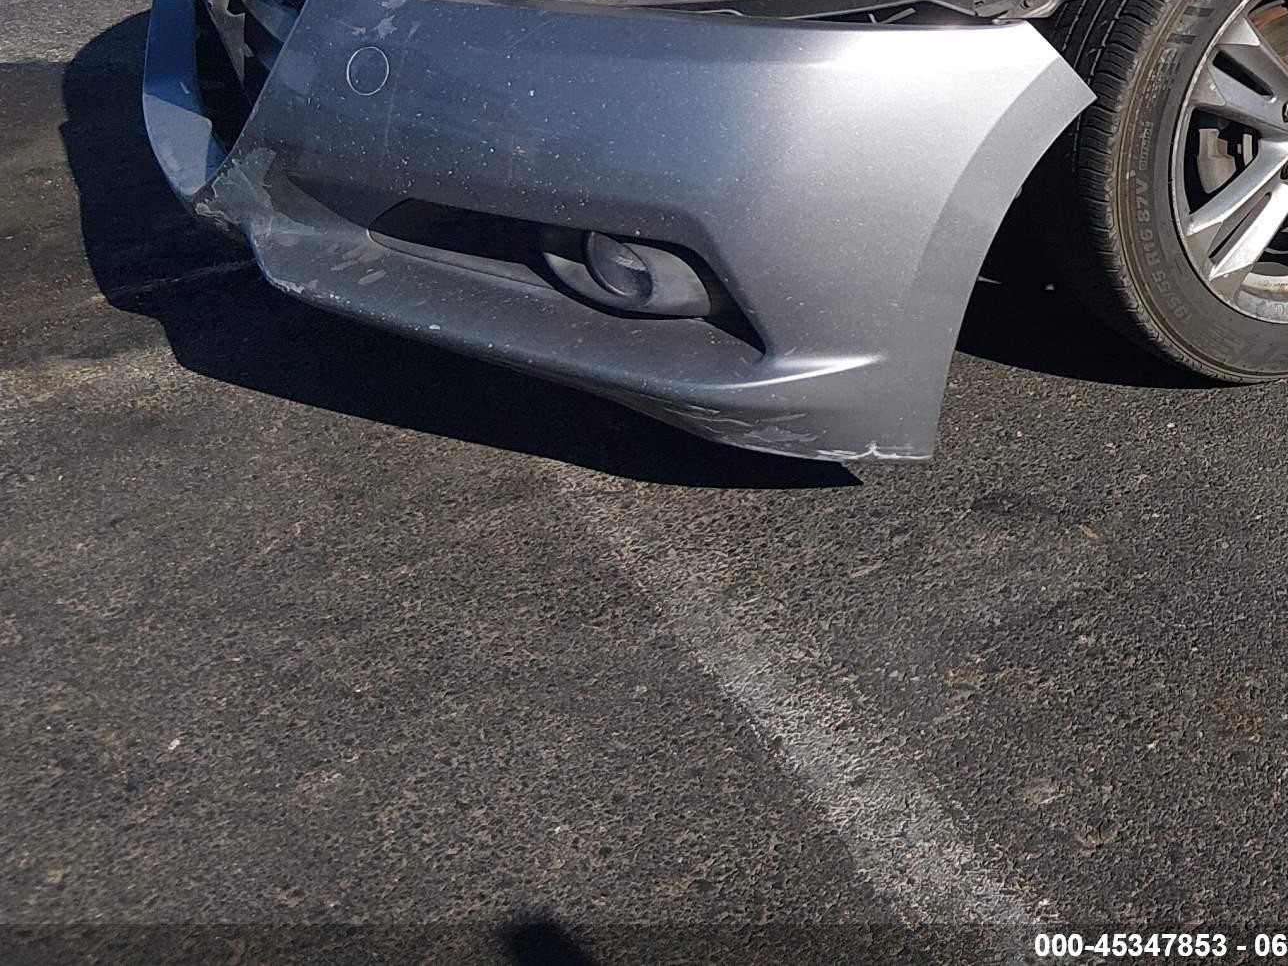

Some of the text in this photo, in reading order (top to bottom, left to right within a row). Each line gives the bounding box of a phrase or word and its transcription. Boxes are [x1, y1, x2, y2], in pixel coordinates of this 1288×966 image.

[1135, 178, 1193, 325] 195/55 R16 87V
